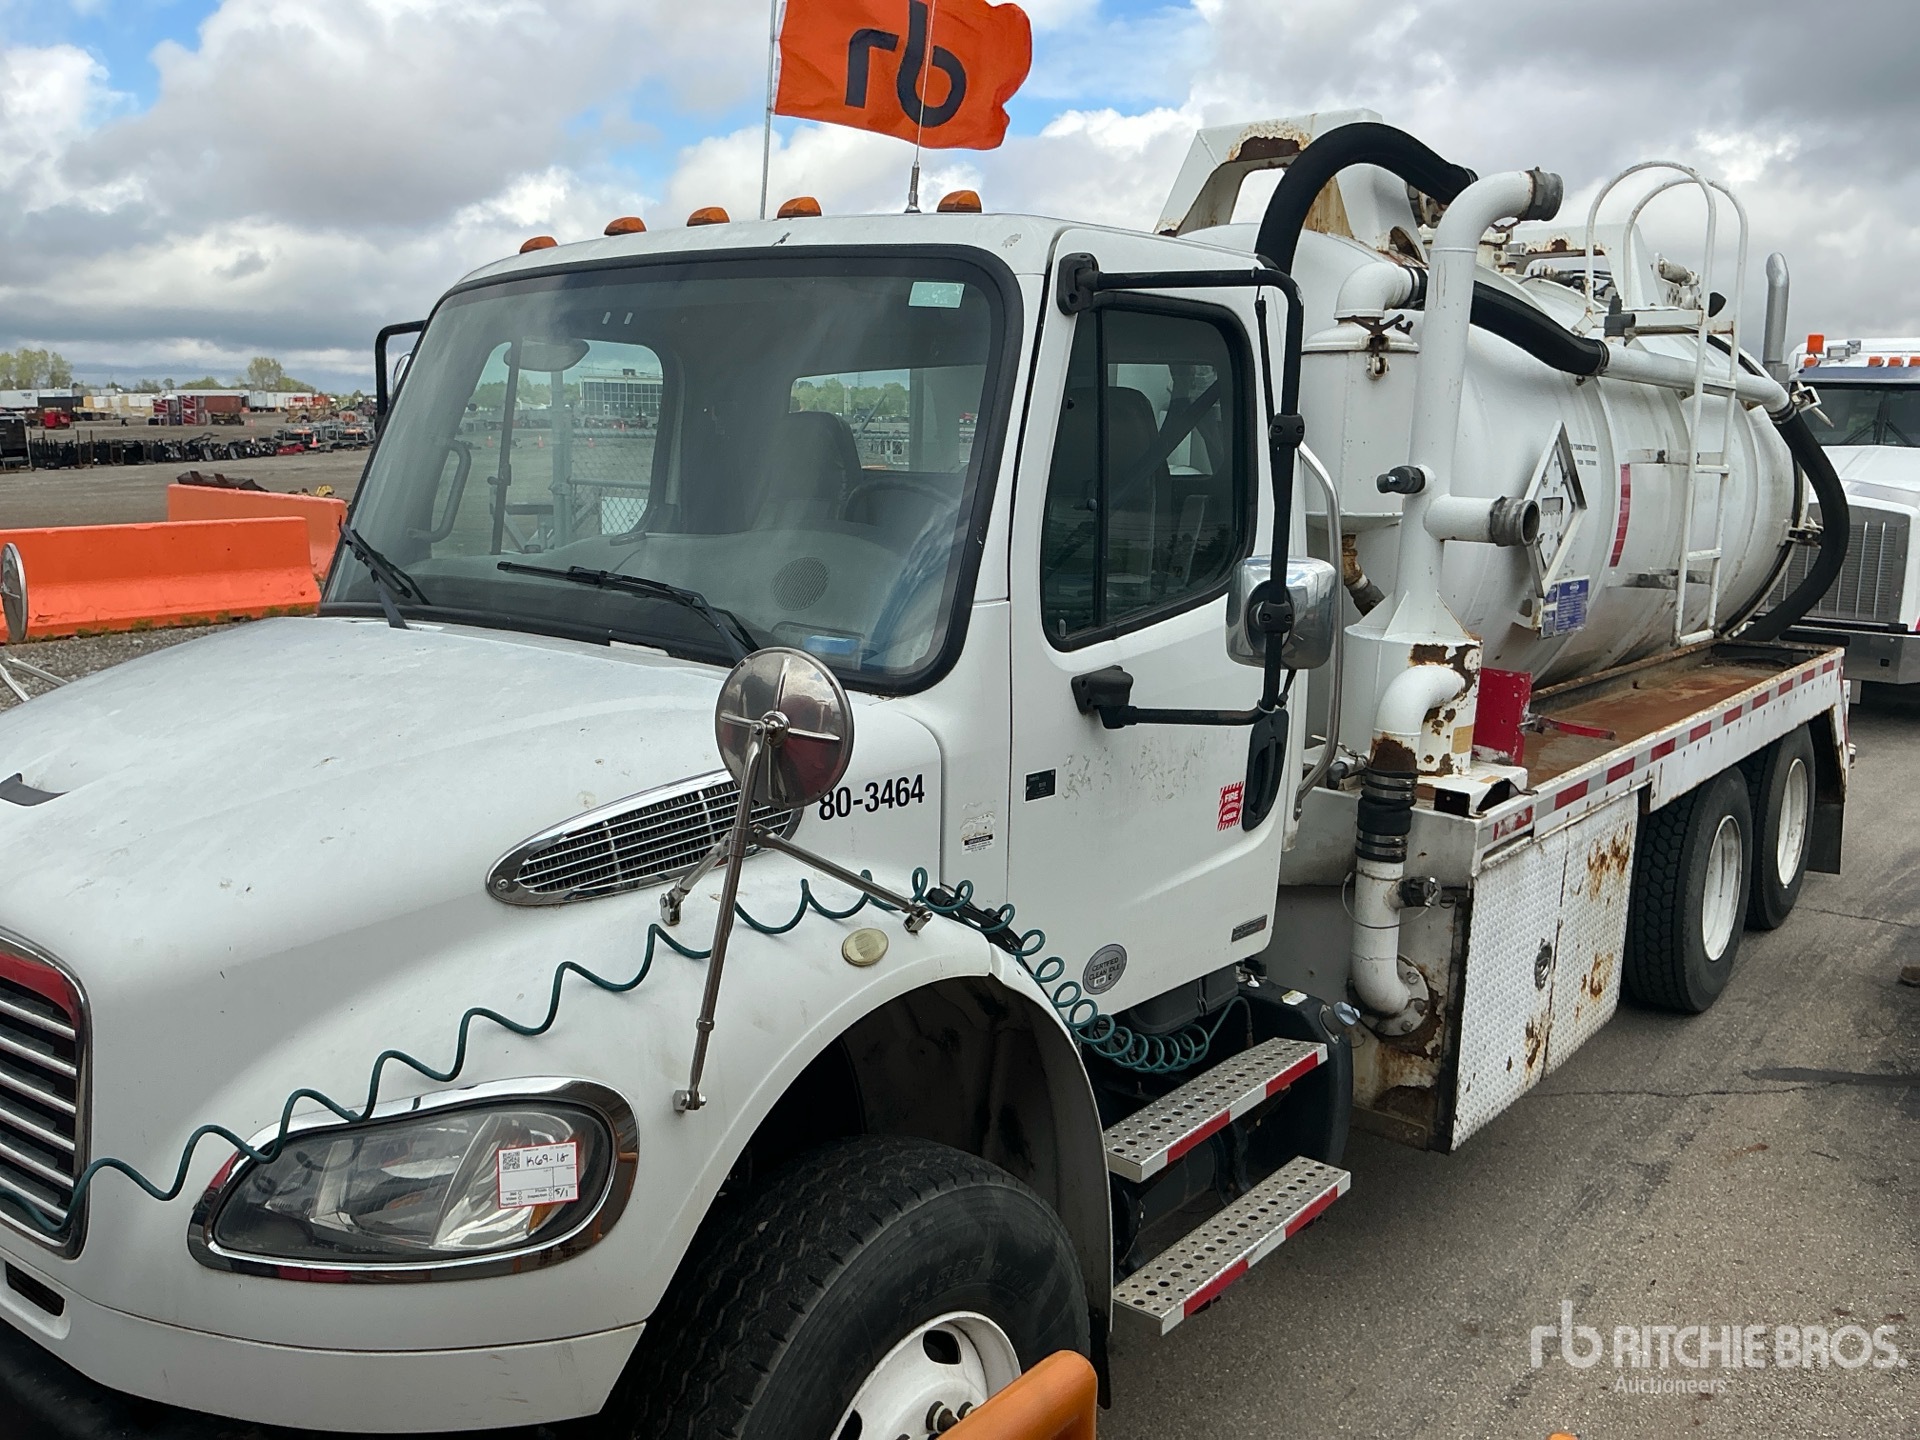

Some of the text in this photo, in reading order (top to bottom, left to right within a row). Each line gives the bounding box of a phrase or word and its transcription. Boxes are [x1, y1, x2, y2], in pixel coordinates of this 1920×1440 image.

[818, 774, 925, 820] 80-3464
[1224, 790, 1240, 803] FIRE
[1088, 968, 1107, 981] CLEAN
[1108, 963, 1121, 973] IDLE
[1091, 956, 1119, 972] CERTIFIED
